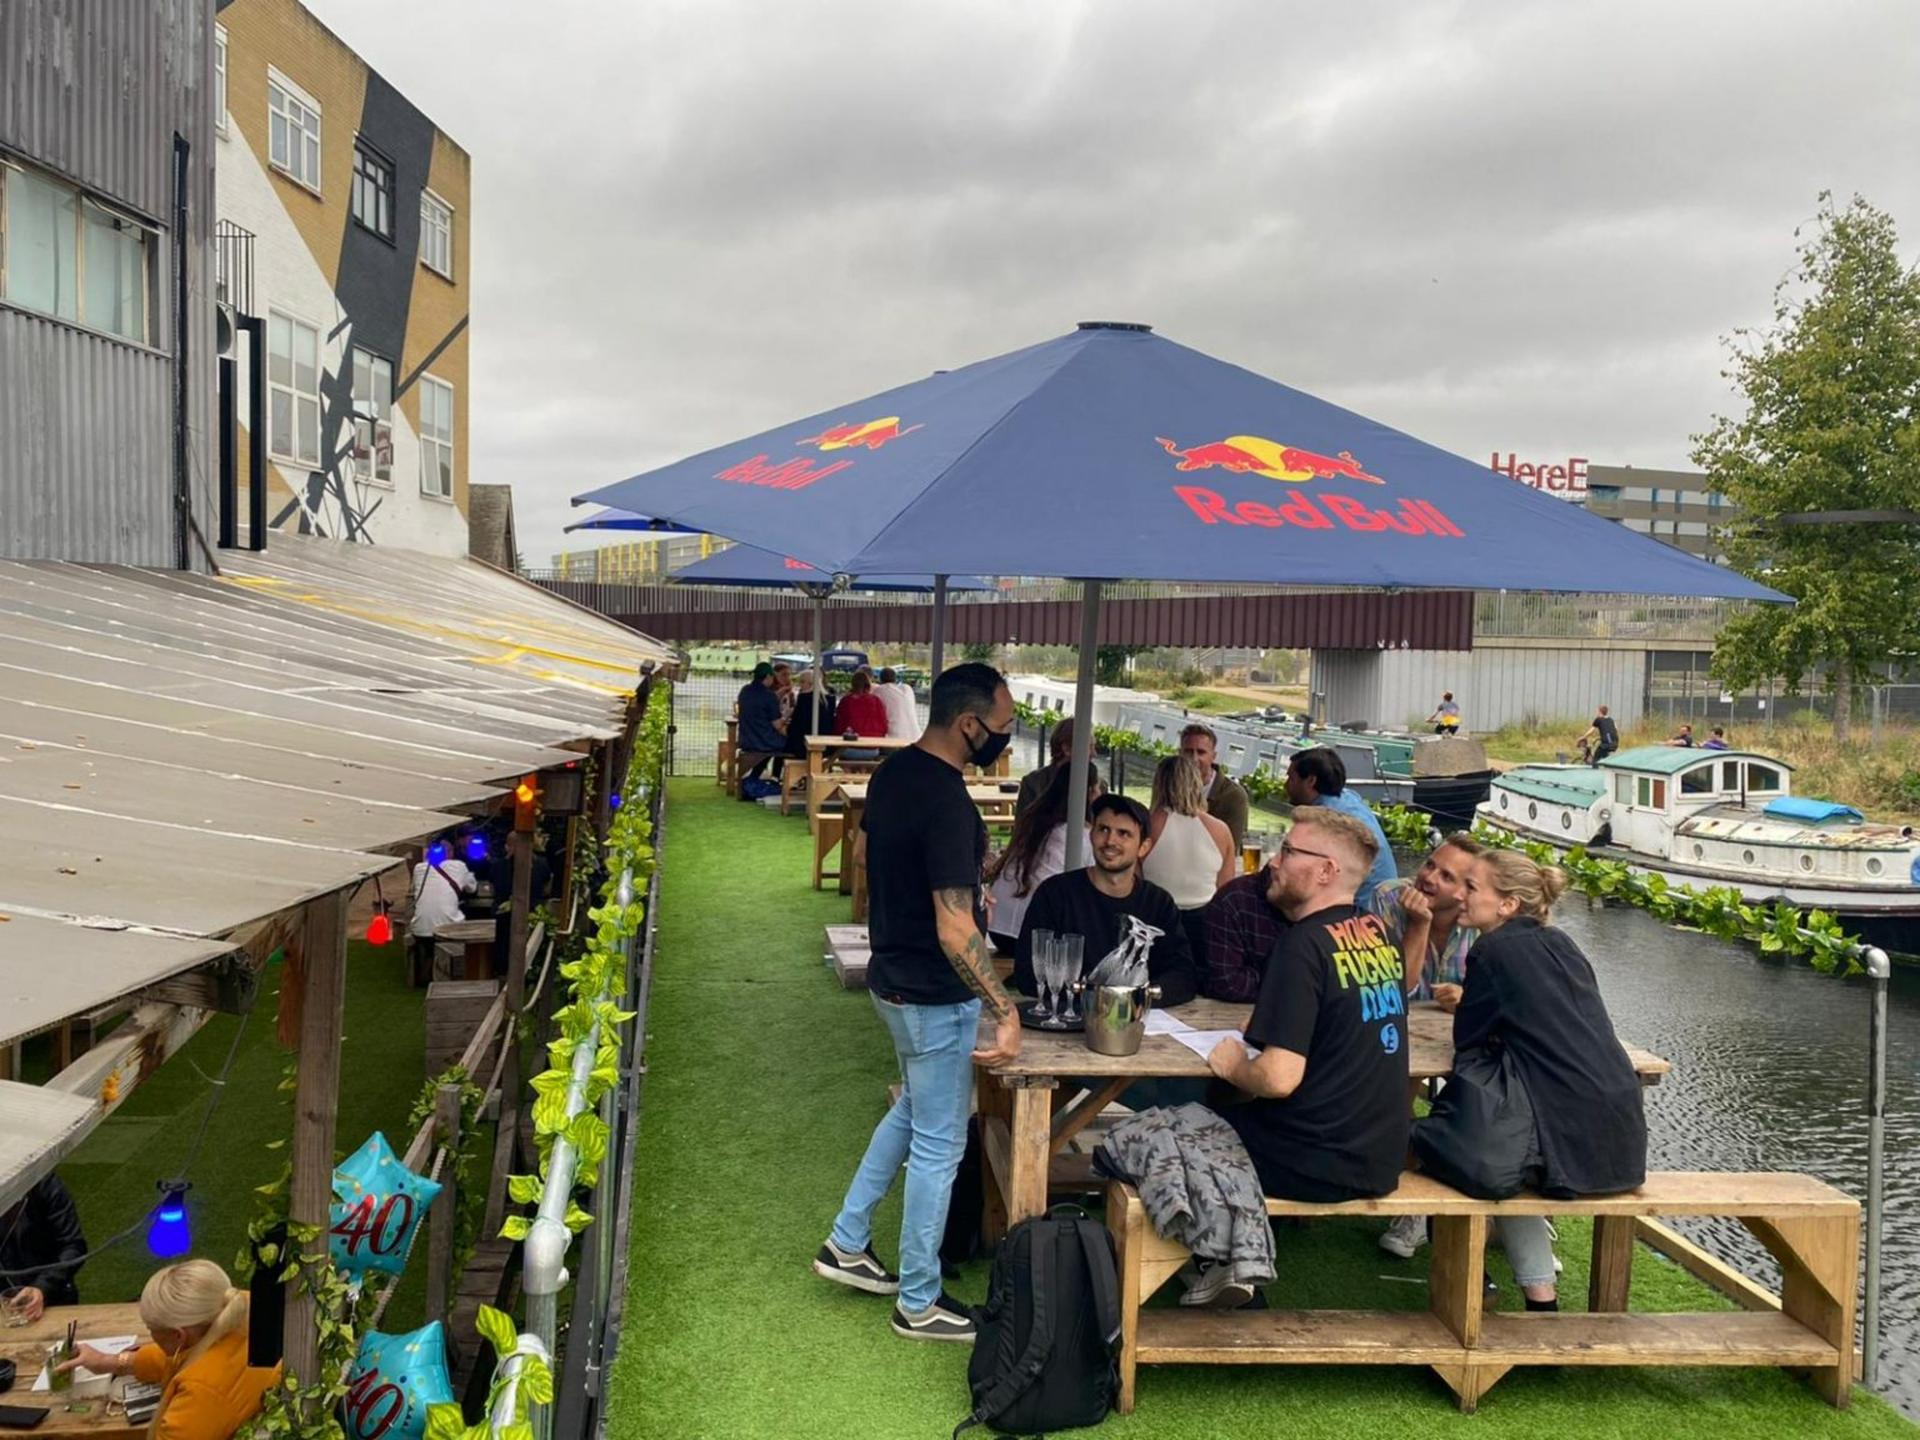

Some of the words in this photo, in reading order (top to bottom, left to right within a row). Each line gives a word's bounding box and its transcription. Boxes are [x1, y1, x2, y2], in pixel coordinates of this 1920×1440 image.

[1173, 486, 1334, 529] Red
[1318, 494, 1465, 537] Bull
[329, 1194, 413, 1256] 40
